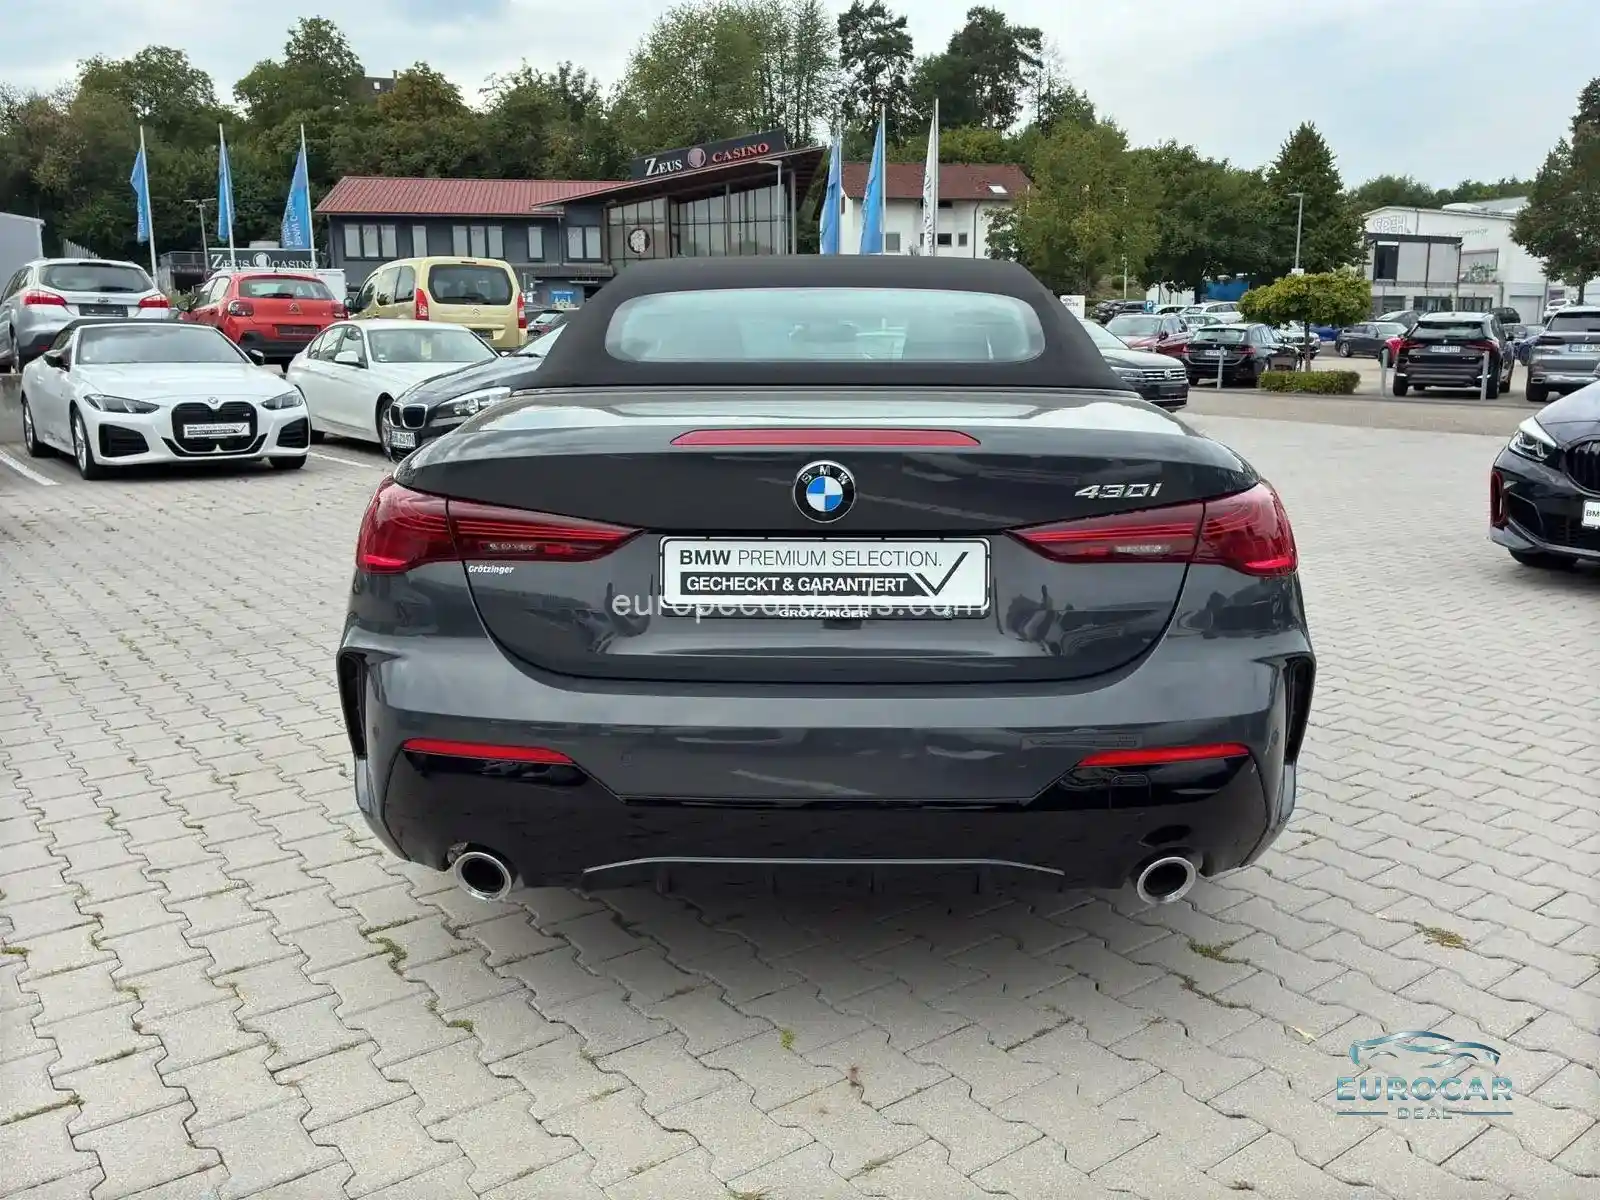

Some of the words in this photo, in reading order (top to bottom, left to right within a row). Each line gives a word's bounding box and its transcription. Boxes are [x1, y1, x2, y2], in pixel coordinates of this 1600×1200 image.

[645, 157, 683, 177] ZEUS
[711, 142, 770, 164] CASINO
[801, 465, 850, 485] BMW
[1074, 482, 1162, 499] 430i
[679, 549, 731, 566] BMW
[738, 550, 827, 567] PREMIUM
[468, 565, 515, 575] Grötzinger
[686, 576, 779, 592] GECHECKT
[782, 577, 795, 592] &
[797, 577, 908, 592] GARANTIERT
